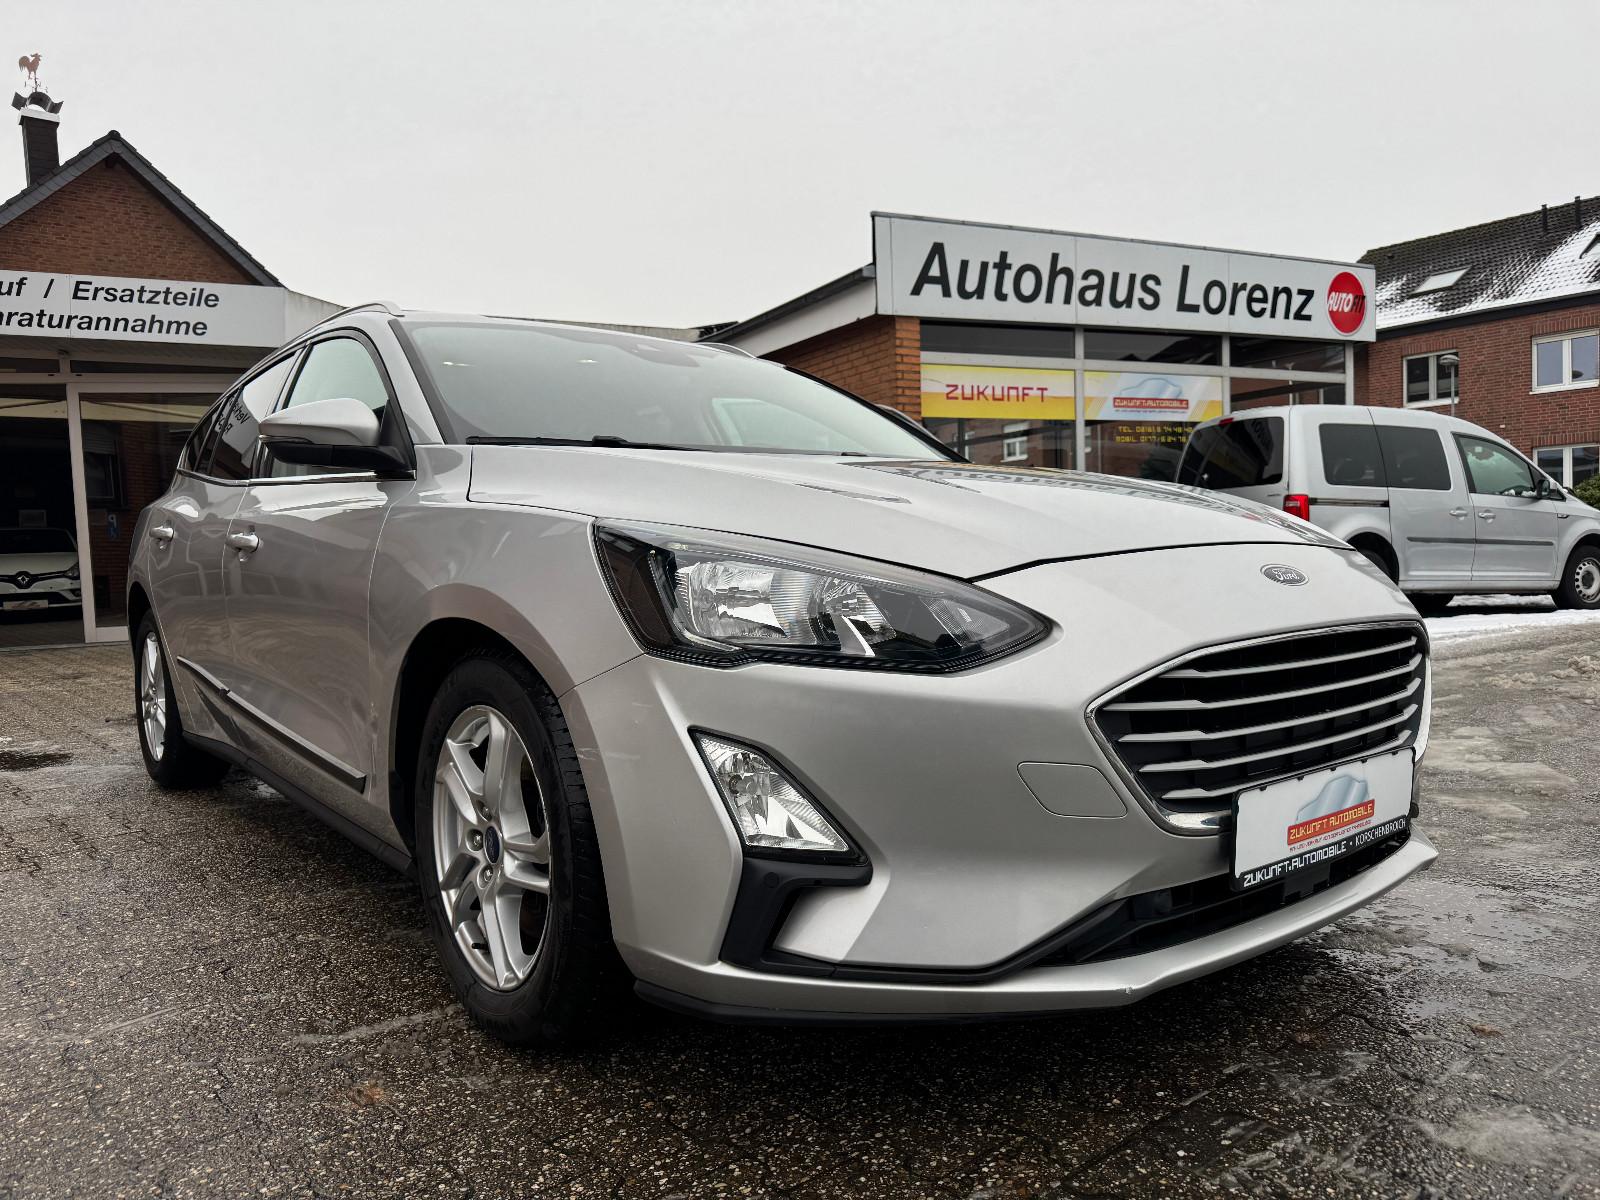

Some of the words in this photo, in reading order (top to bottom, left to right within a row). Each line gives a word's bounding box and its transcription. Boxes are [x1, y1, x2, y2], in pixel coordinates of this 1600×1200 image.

[72, 280, 220, 308] Ersatzteile
[910, 241, 1162, 311] Autohaus
[1176, 264, 1315, 322] Lorenz
[945, 383, 1049, 403] ZUKUNFT
[1271, 568, 1301, 581] Ford
[1243, 840, 1347, 887] ZUKUNFT.AUTOMOBILE
[1355, 817, 1406, 846] KORSCHENBROICH
